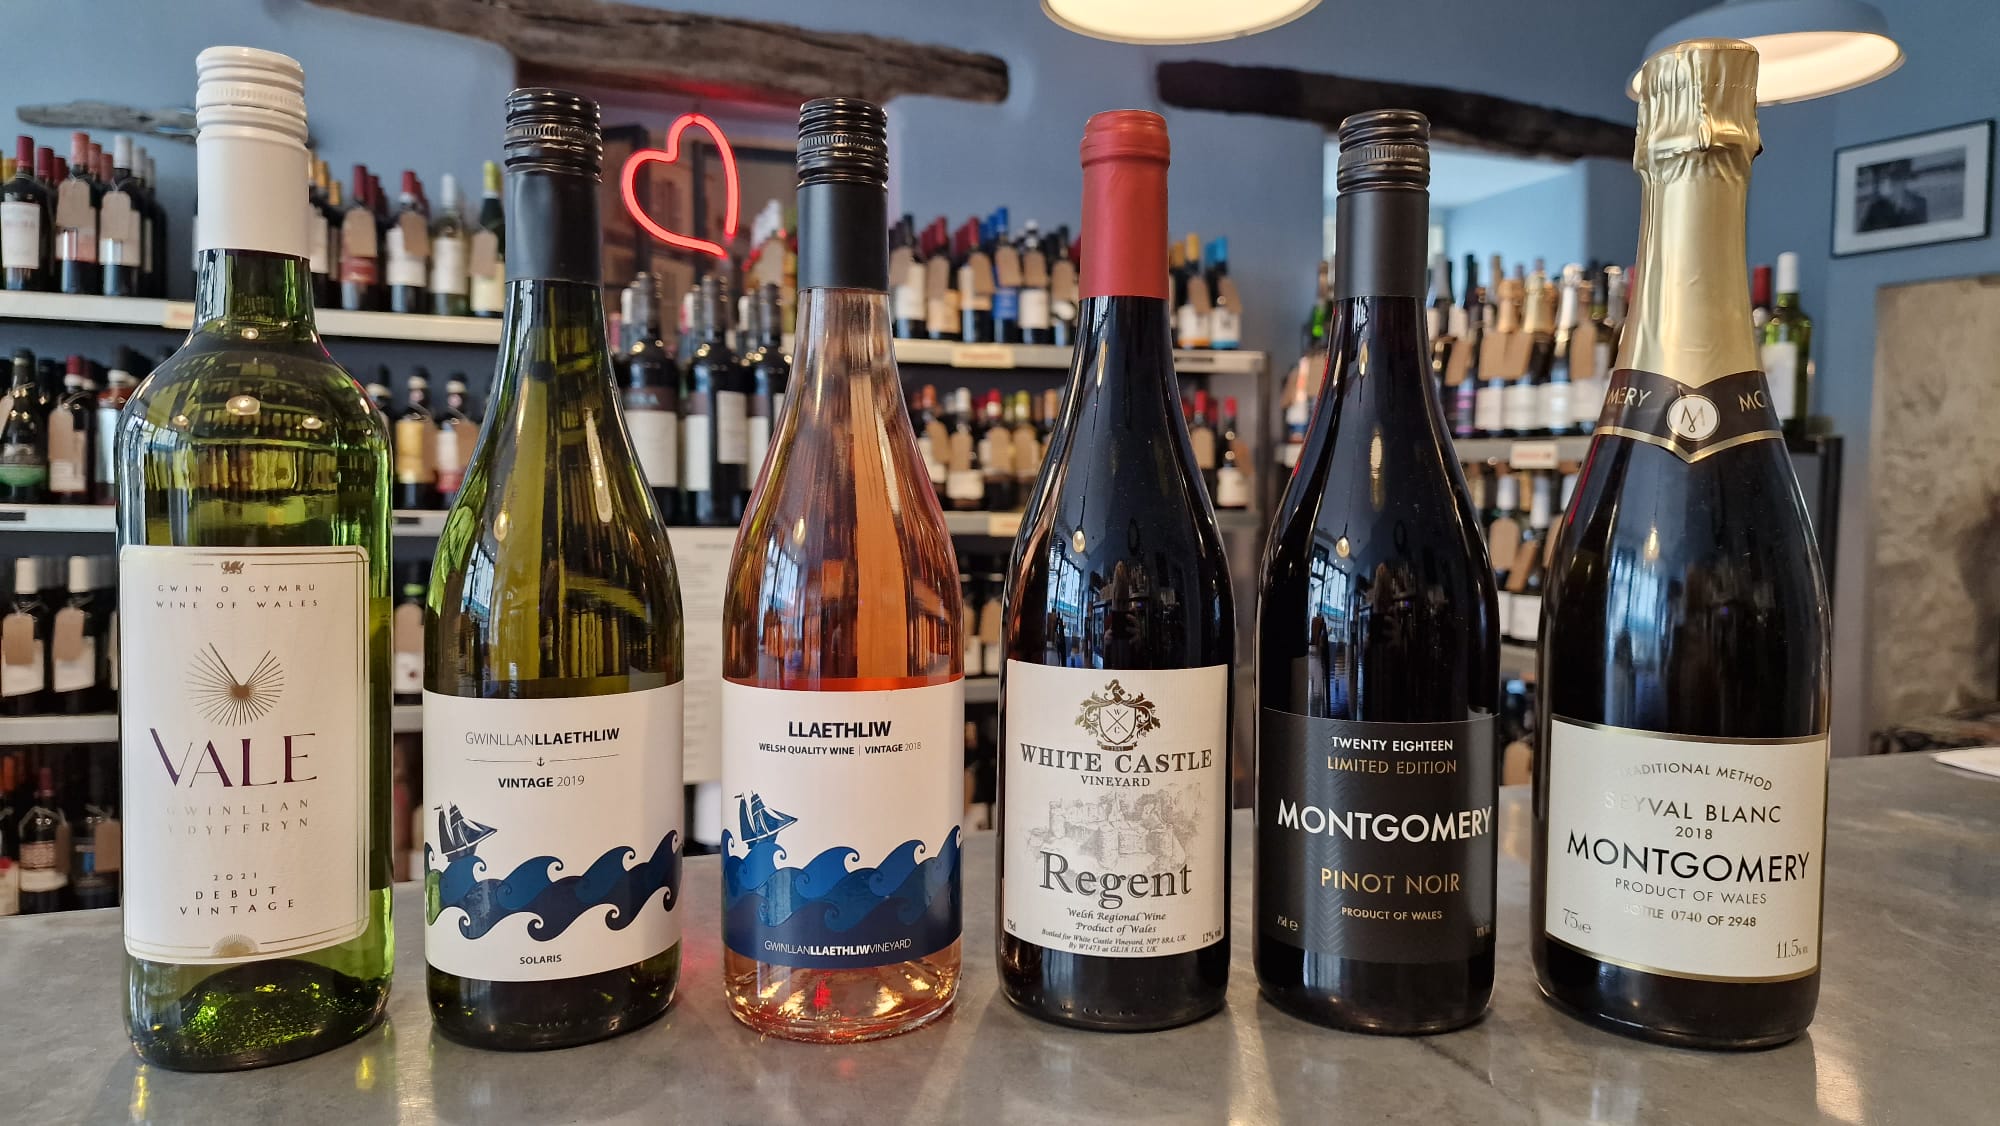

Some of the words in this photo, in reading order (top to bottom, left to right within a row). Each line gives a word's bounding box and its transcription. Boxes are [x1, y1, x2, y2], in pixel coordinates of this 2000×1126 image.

[248, 584, 315, 592] GYMRU
[257, 600, 317, 608] WALES
[465, 728, 620, 746] GWINLLANLLAETHLIW
[788, 720, 892, 738] LLAETHLIW
[758, 742, 786, 753] WELSH
[788, 745, 828, 755] QUALITY
[830, 746, 855, 755] WINE
[864, 744, 903, 754] VINTAGE
[904, 741, 922, 752] 2018
[1332, 736, 1388, 752] TWENTY
[1392, 739, 1454, 752] EIGHTEEN
[150, 728, 318, 788] VALE
[1020, 742, 1102, 773] WHITE
[1114, 748, 1212, 774] CASTLE
[1327, 756, 1389, 774] LIMITED
[1396, 758, 1457, 775] EDITION
[498, 777, 554, 788] VINTAGE
[556, 775, 585, 787] 2019
[1080, 774, 1150, 788] VINEYARD
[1716, 766, 1772, 791] METHOD
[1278, 798, 1492, 843] MONTGOMERY
[1706, 804, 1782, 824] BLANC
[188, 818, 308, 836] DYFFRYN
[1675, 826, 1713, 840] 2018
[1567, 829, 1810, 883] MONTGOMERY
[213, 872, 257, 881] 2021
[1040, 850, 1192, 910] Regent
[1321, 868, 1395, 894] PINOT
[1406, 872, 1460, 895] NOIR
[196, 886, 277, 900] DEBUT
[1615, 878, 1685, 900] PRODUCT
[1692, 890, 1714, 902] OF
[1720, 892, 1767, 904] WALES
[180, 899, 294, 916] VINTAGE
[1066, 908, 1094, 920] Welsh
[1096, 910, 1140, 924] Regional
[1140, 910, 1167, 921] Wine
[1341, 906, 1390, 920] PRODUCT
[1394, 909, 1408, 920] OF
[1412, 910, 1442, 920] WALES
[1670, 910, 1702, 923] 0740
[1706, 914, 1724, 926] OF
[1728, 916, 1757, 928] 2948
[1076, 922, 1113, 933] Product
[1116, 924, 1128, 936] of
[1128, 924, 1156, 934] Wales
[764, 938, 912, 956] GWINLLANLLAETHLIWVINEYARD
[1073, 934, 1091, 943] White
[519, 954, 562, 965] SOLARIS
